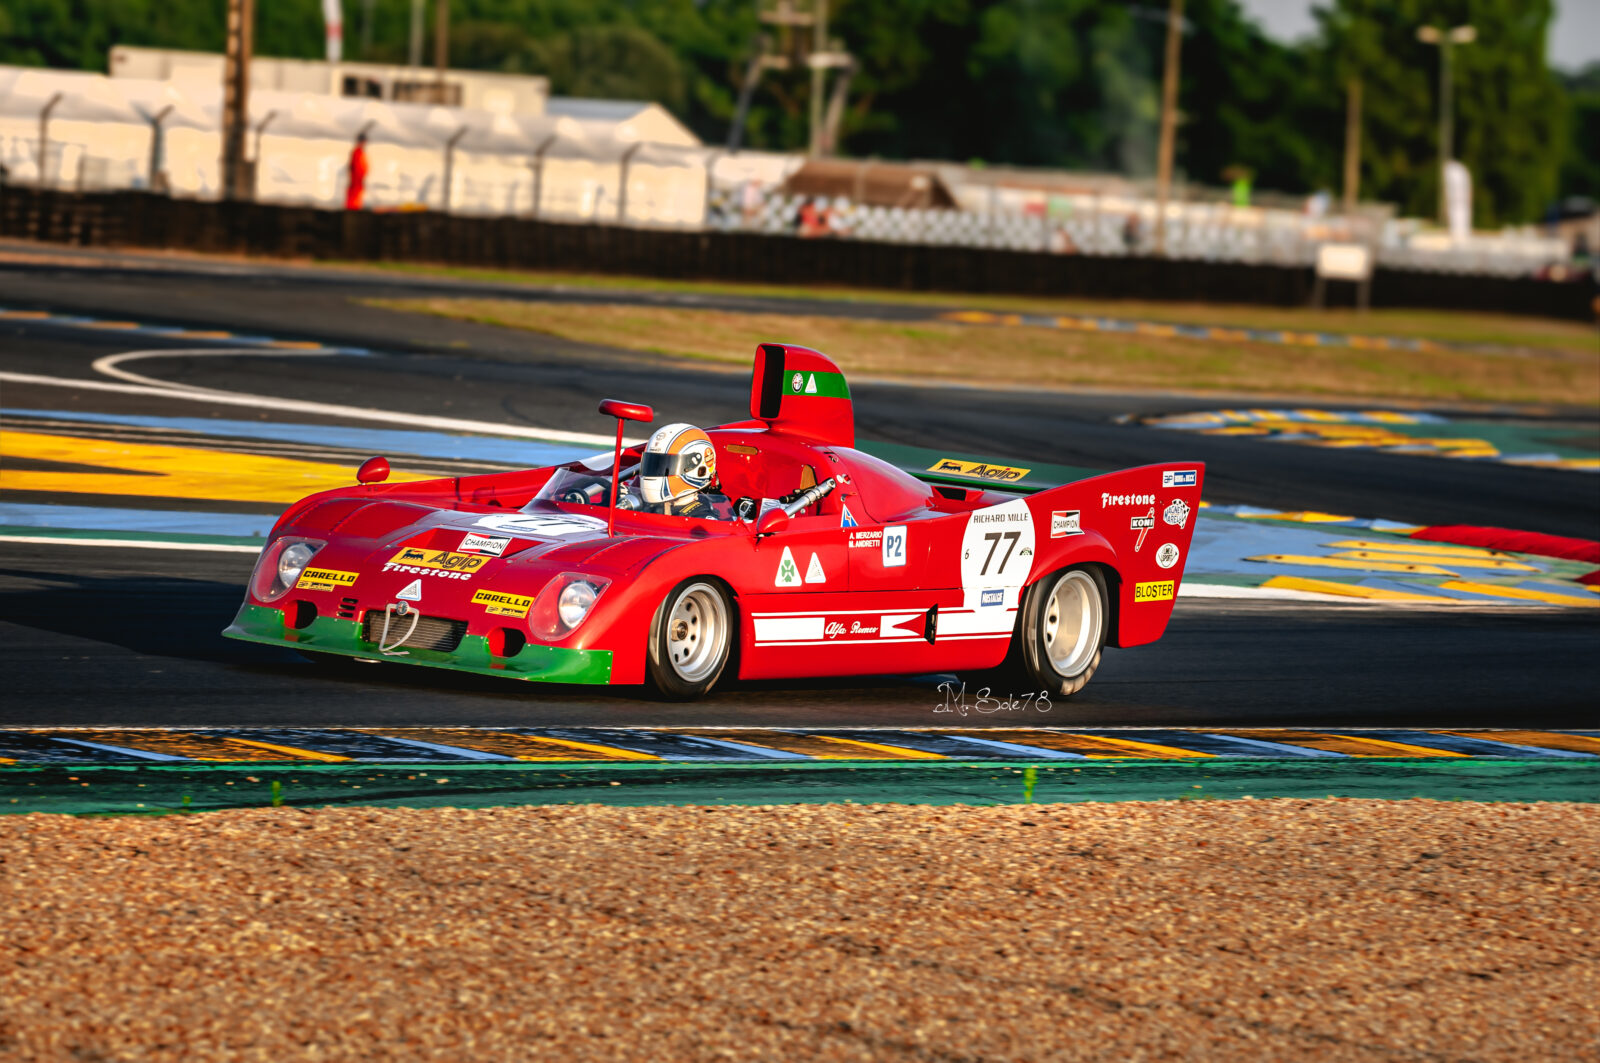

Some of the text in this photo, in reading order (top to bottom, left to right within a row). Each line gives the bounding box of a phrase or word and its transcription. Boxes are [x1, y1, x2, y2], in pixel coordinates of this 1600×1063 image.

[965, 464, 1020, 479] Agip
[1101, 492, 1156, 508] Firestone
[974, 512, 1029, 524] RICHARD MILLE
[1053, 519, 1079, 530] CHAMPION
[1132, 518, 1154, 528] KONI
[856, 531, 882, 539] MERZARIO
[464, 538, 504, 550] CHAMPION
[887, 535, 902, 557] P2
[426, 551, 482, 570] Agip
[980, 531, 1022, 576] 77
[303, 570, 356, 582] CARELLO
[381, 562, 472, 581] Firestone
[1135, 584, 1173, 598] BLOSTER
[475, 592, 531, 607] CARELLO
[824, 620, 879, 639] Alfa Romeo
